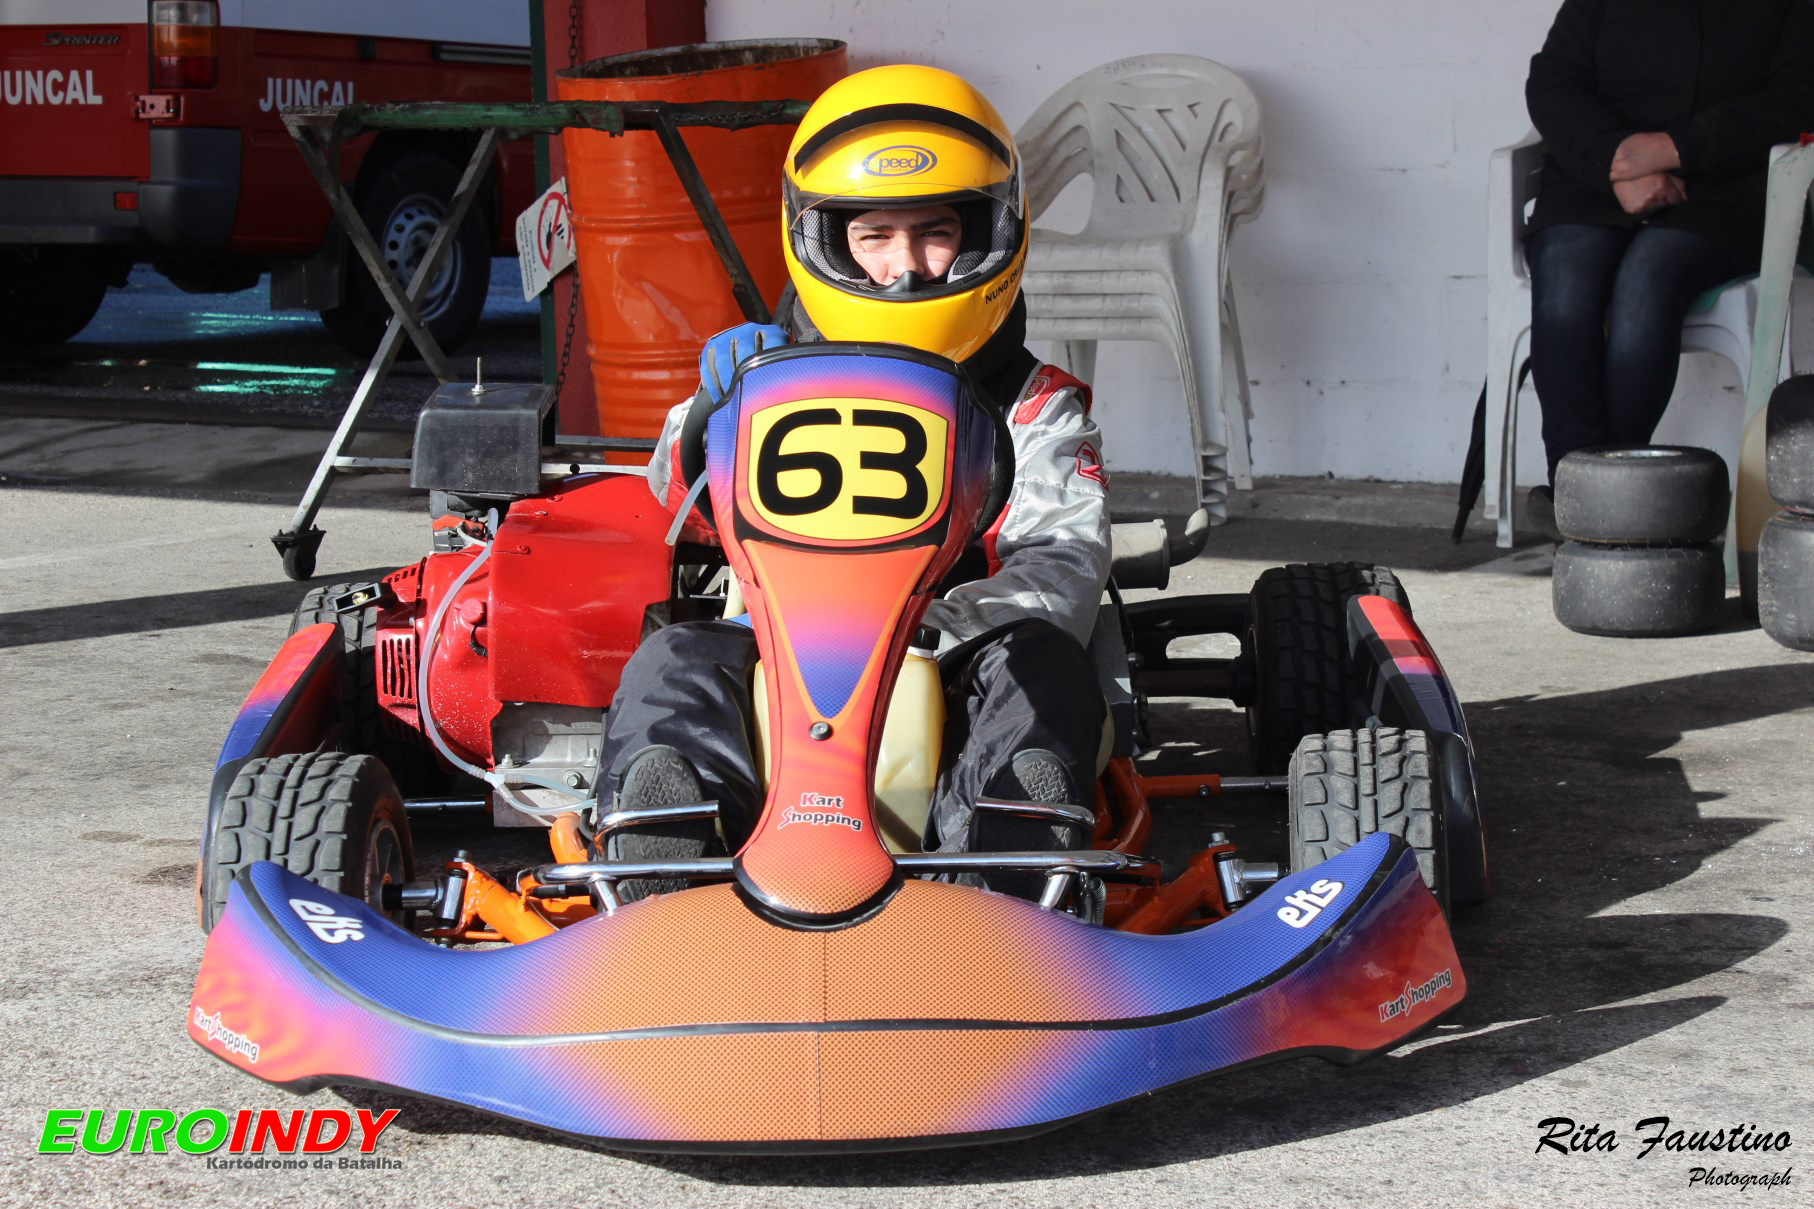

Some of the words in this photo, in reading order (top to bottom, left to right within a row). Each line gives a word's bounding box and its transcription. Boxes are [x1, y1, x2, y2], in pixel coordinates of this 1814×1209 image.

[44, 32, 120, 46] SPRINTER
[0, 70, 103, 105] UNCAL
[985, 280, 1008, 304] NUNO
[757, 408, 928, 519] 63
[801, 793, 843, 808] Kart
[778, 806, 862, 831] Shopping
